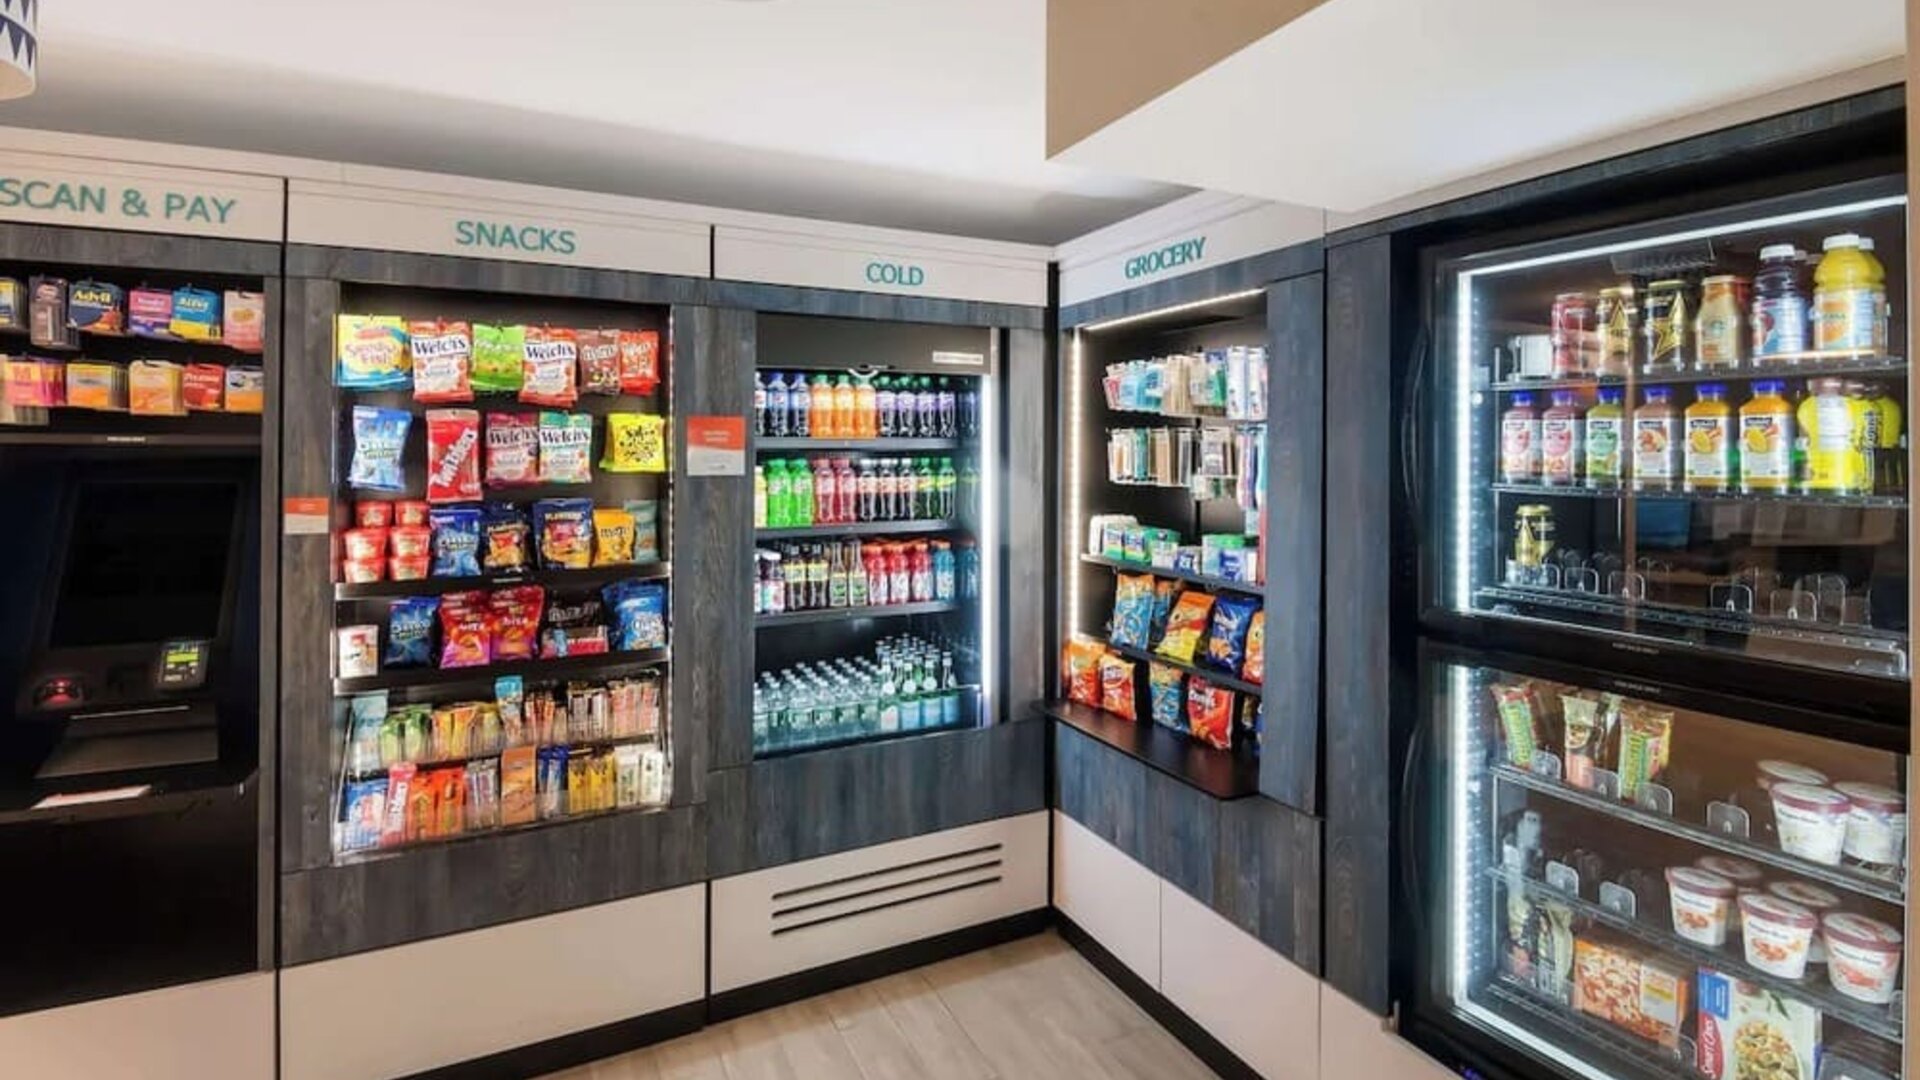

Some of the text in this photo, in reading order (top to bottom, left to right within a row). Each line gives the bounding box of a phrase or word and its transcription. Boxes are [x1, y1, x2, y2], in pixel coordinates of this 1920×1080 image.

[0, 178, 236, 223] SCAN & PAY
[455, 220, 576, 254] SNACKS
[1124, 236, 1207, 280] GROCERY
[865, 262, 924, 286] COLD
[413, 338, 467, 355] Welch's
[526, 343, 575, 360] Welch's
[541, 428, 590, 444] Welch's
